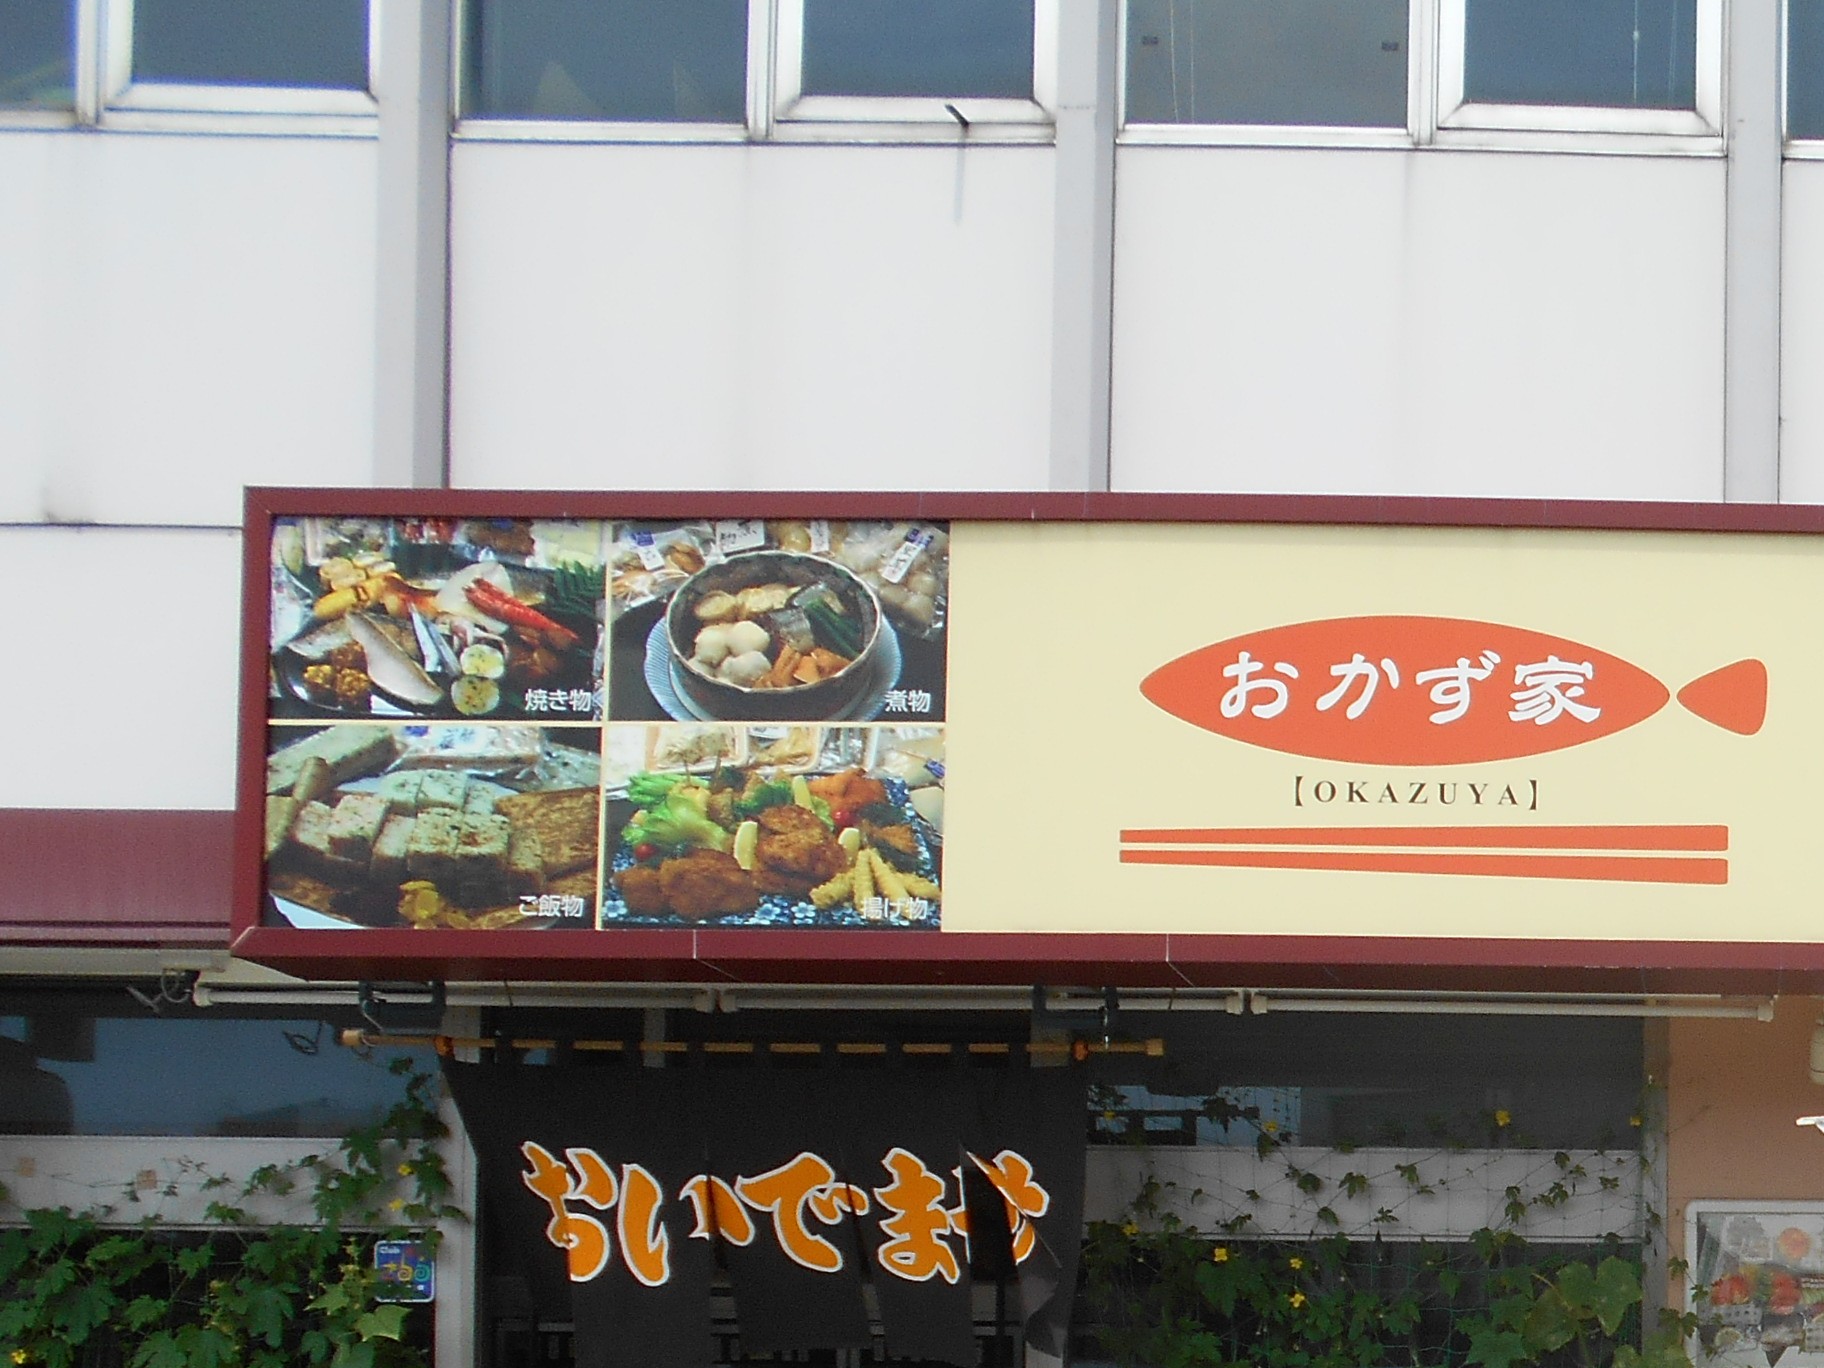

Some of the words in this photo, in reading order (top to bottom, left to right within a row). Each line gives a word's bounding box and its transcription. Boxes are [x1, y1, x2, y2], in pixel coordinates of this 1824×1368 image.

[1218, 649, 1602, 726] おかず家
[525, 688, 593, 713] 焼き物
[885, 689, 931, 713] 煮物
[518, 893, 584, 918] ご飯物
[861, 896, 929, 921] 揚げ物
